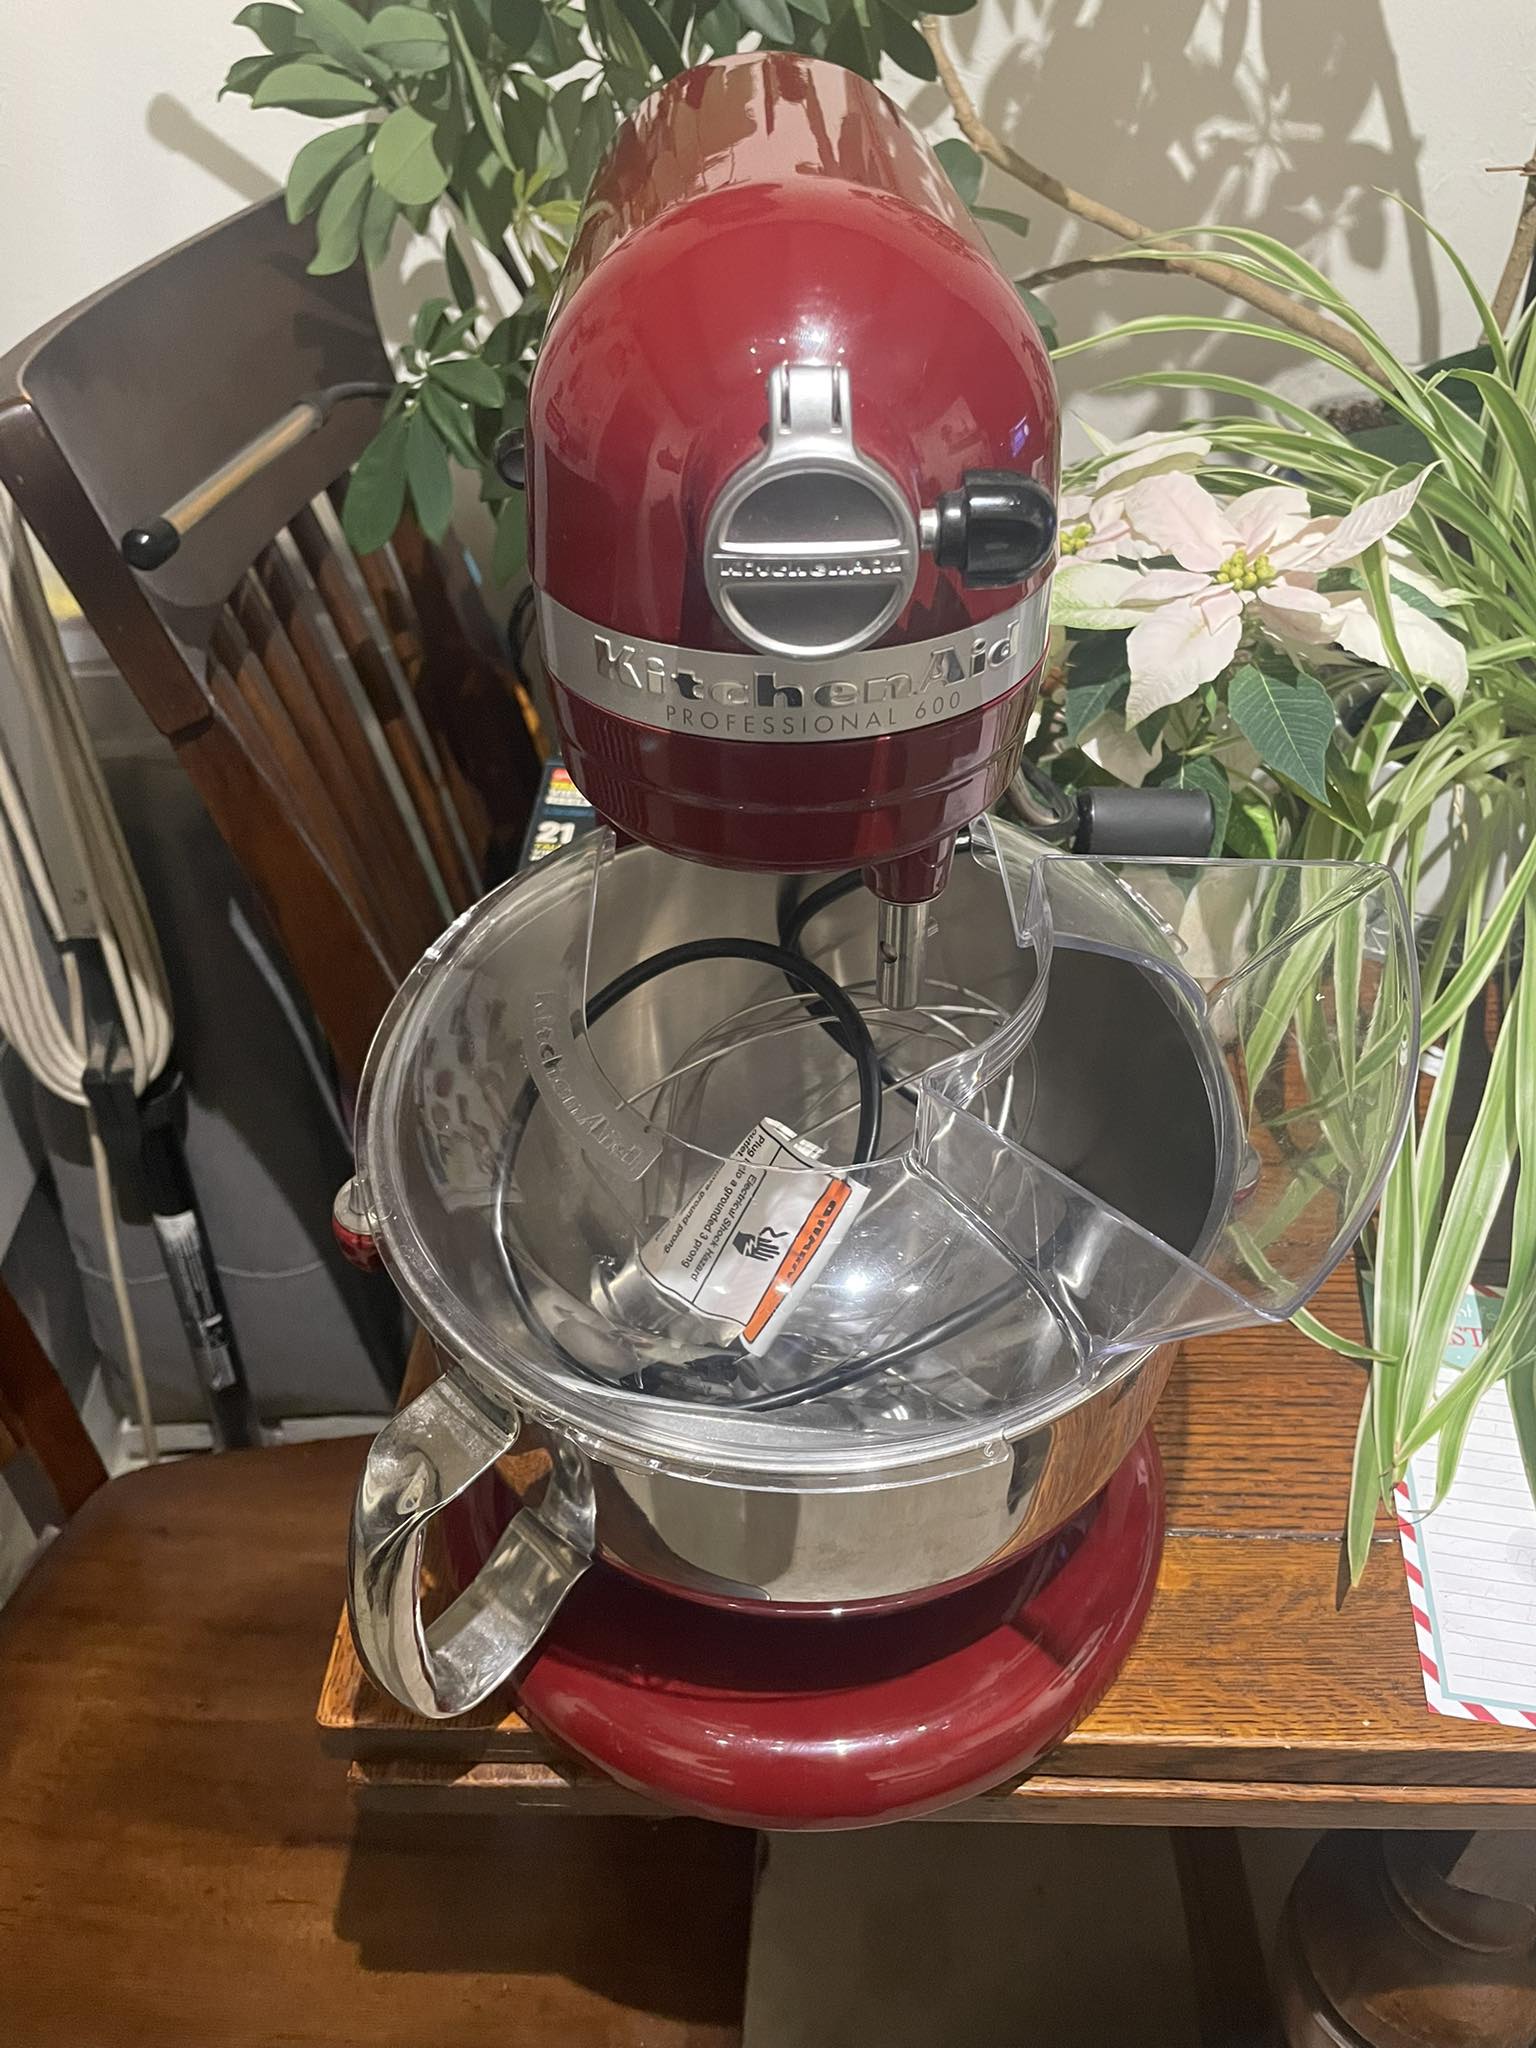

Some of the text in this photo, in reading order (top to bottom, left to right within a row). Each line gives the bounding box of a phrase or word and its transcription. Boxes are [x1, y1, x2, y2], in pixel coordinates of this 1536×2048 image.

[594, 618, 1019, 708] KitchenAid
[665, 690, 961, 736] PROFESSIONAL 600
[535, 820, 576, 845] 21
[746, 1134, 765, 1157] Plug
[729, 1179, 737, 1187] a
[680, 1190, 705, 1225] ground
[703, 1186, 732, 1232] grounded
[691, 1173, 757, 1281] Electrical Shock Hazard
[698, 1231, 709, 1240] 3
[680, 1238, 701, 1268] prong
